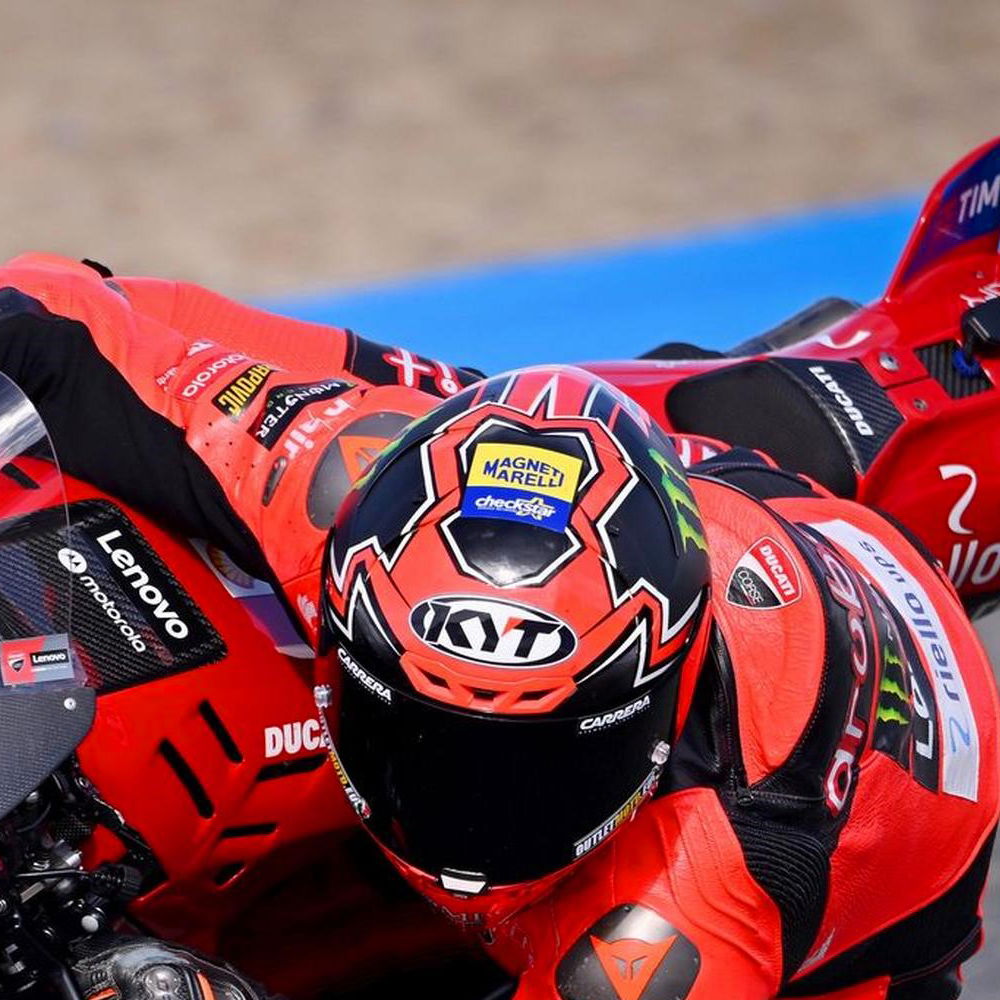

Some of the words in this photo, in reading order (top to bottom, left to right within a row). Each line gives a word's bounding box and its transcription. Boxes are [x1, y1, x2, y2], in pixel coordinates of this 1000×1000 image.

[182, 351, 248, 397] otorola
[808, 366, 874, 437] DUCATI
[483, 457, 564, 482] MAGNETI
[483, 461, 564, 487] MARELLI
[475, 495, 556, 519] checkstar
[98, 529, 188, 639] Lenovo
[759, 545, 797, 597] DUCATI
[859, 540, 906, 583] ups
[737, 569, 764, 605] CORSE
[80, 575, 146, 653] motorola
[426, 604, 562, 660] KYT
[31, 653, 66, 664] Lenovo
[905, 591, 960, 702] riello
[338, 648, 391, 701] CARRERA
[580, 695, 650, 730] CARRERA
